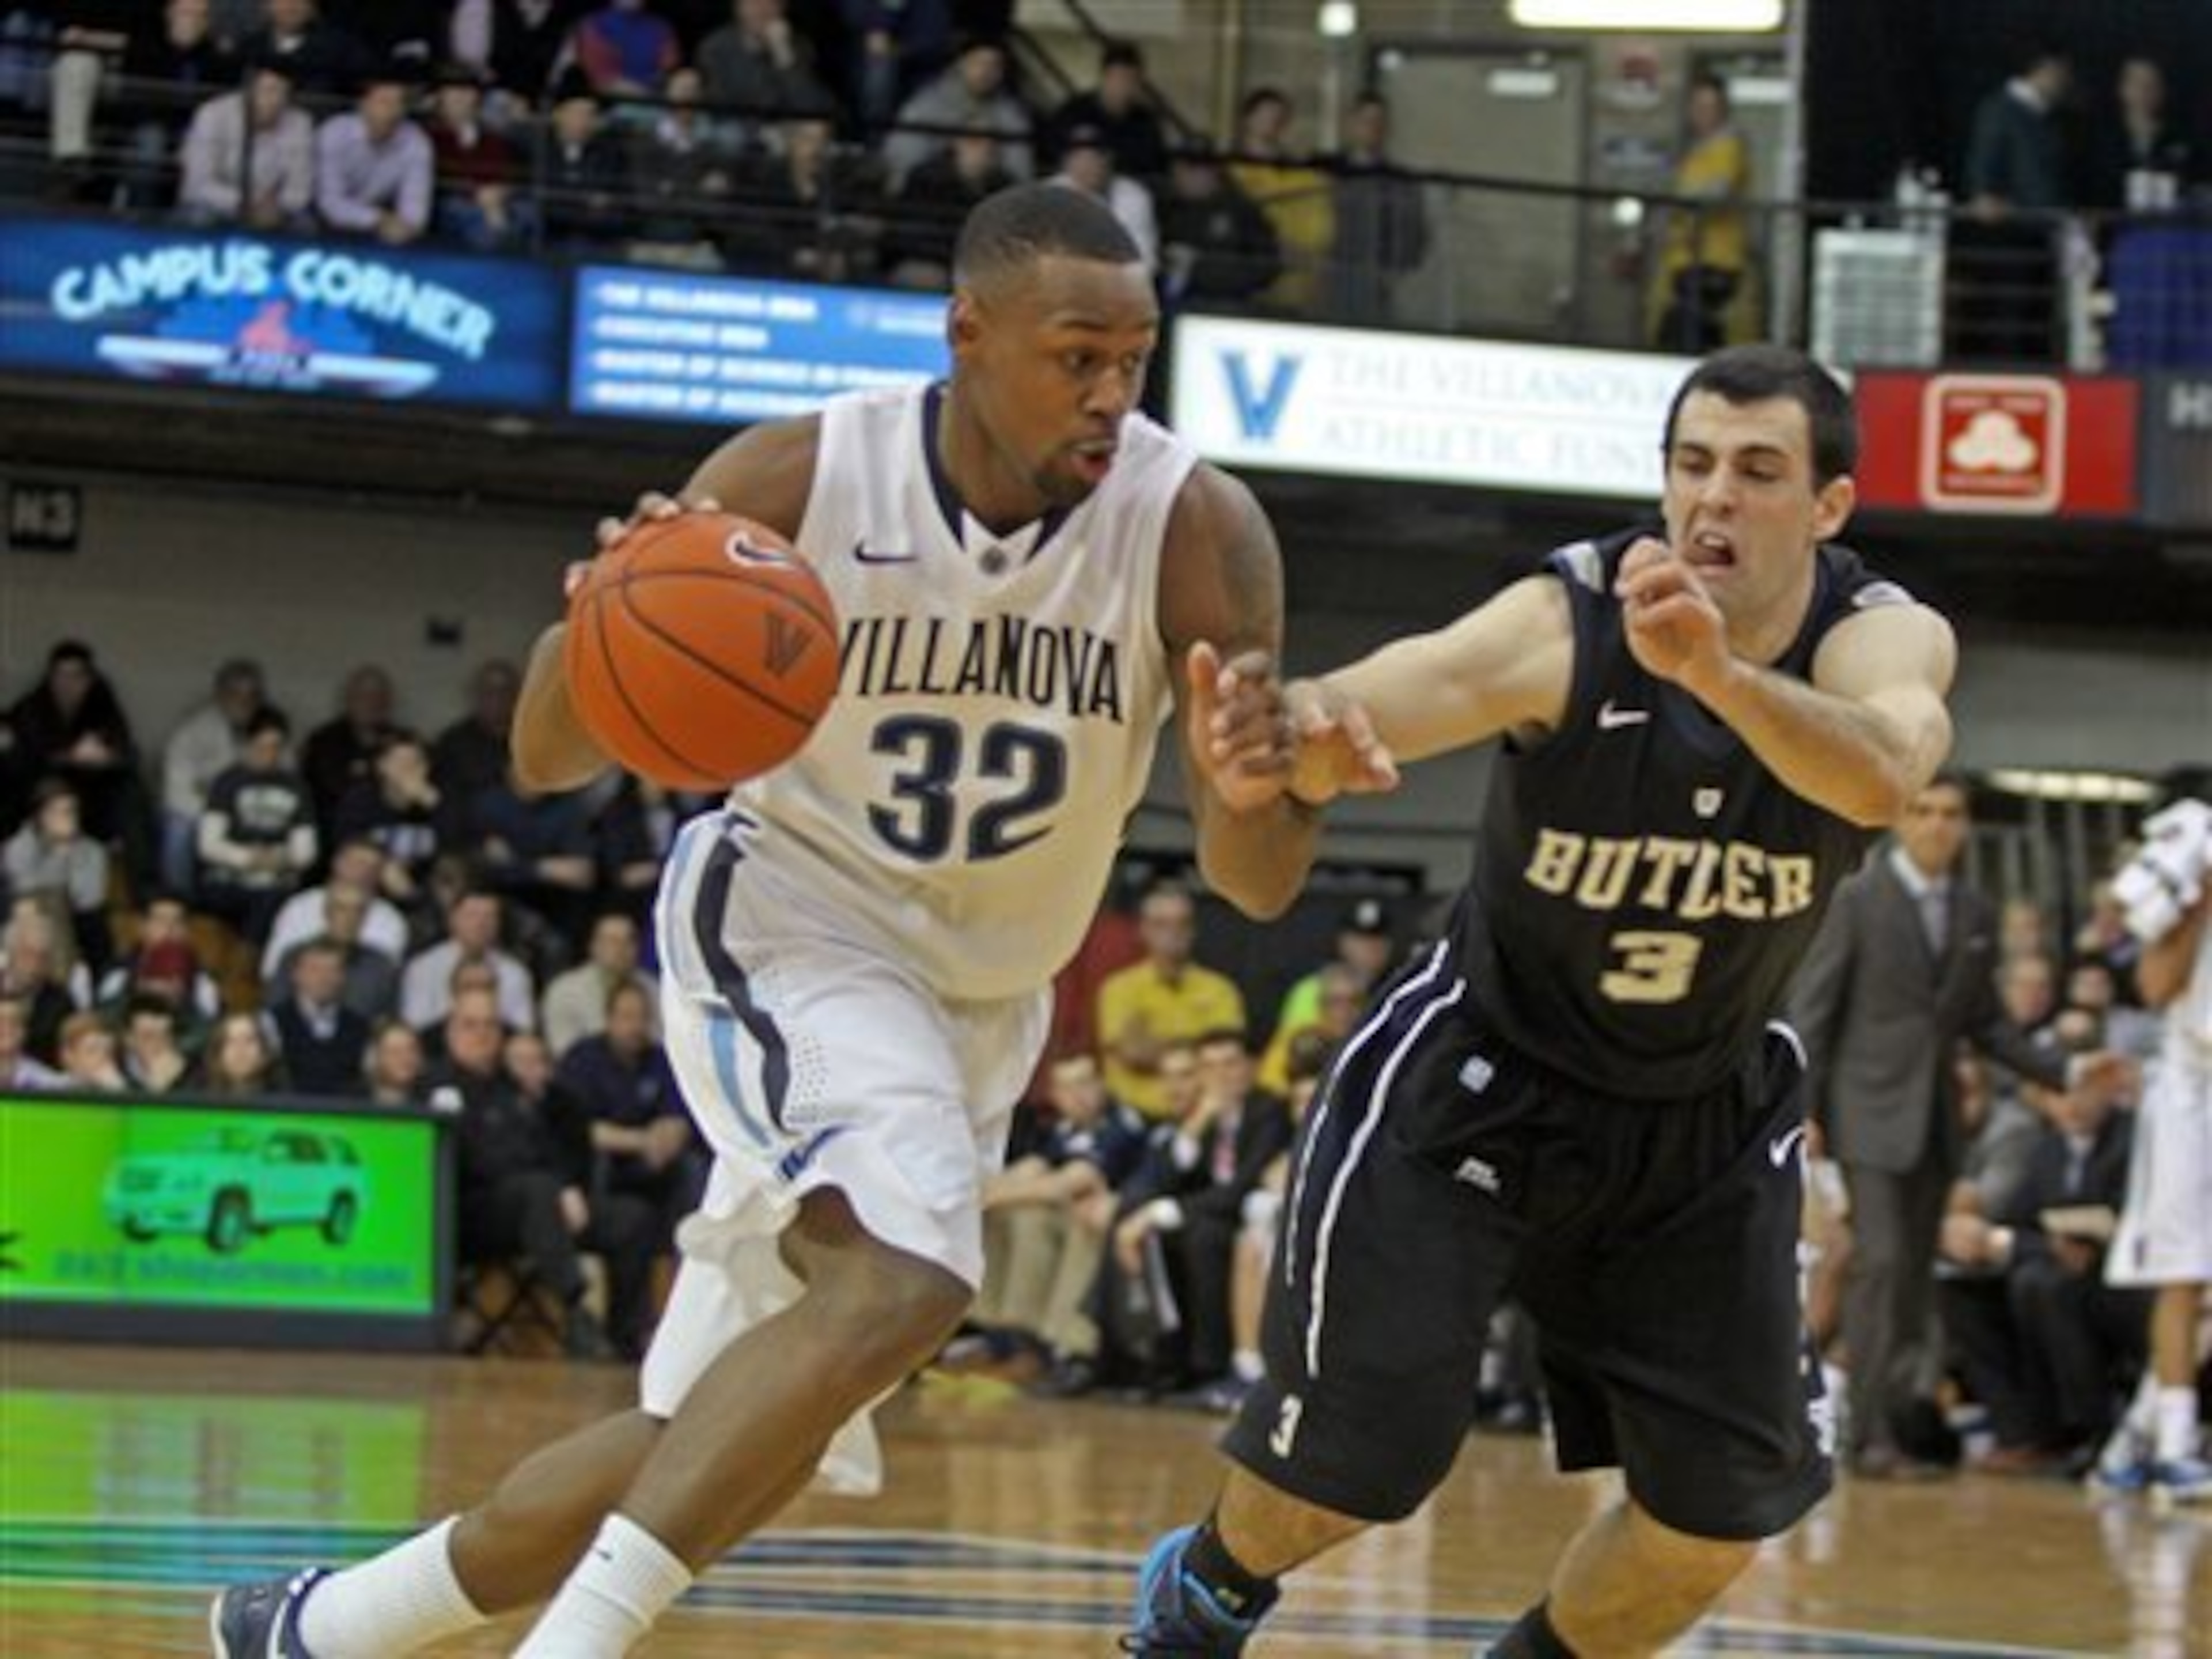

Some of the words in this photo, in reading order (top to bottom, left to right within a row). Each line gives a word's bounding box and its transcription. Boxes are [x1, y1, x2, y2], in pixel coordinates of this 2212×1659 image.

[52, 242, 272, 320] CAMPUS
[286, 250, 494, 359] CORNER
[1550, 431, 1654, 476] FUN
[868, 713, 1068, 862] 32
[1524, 827, 1813, 920] BUTLER
[1599, 930, 1703, 1003] 3
[1269, 1393, 1303, 1459] 3
